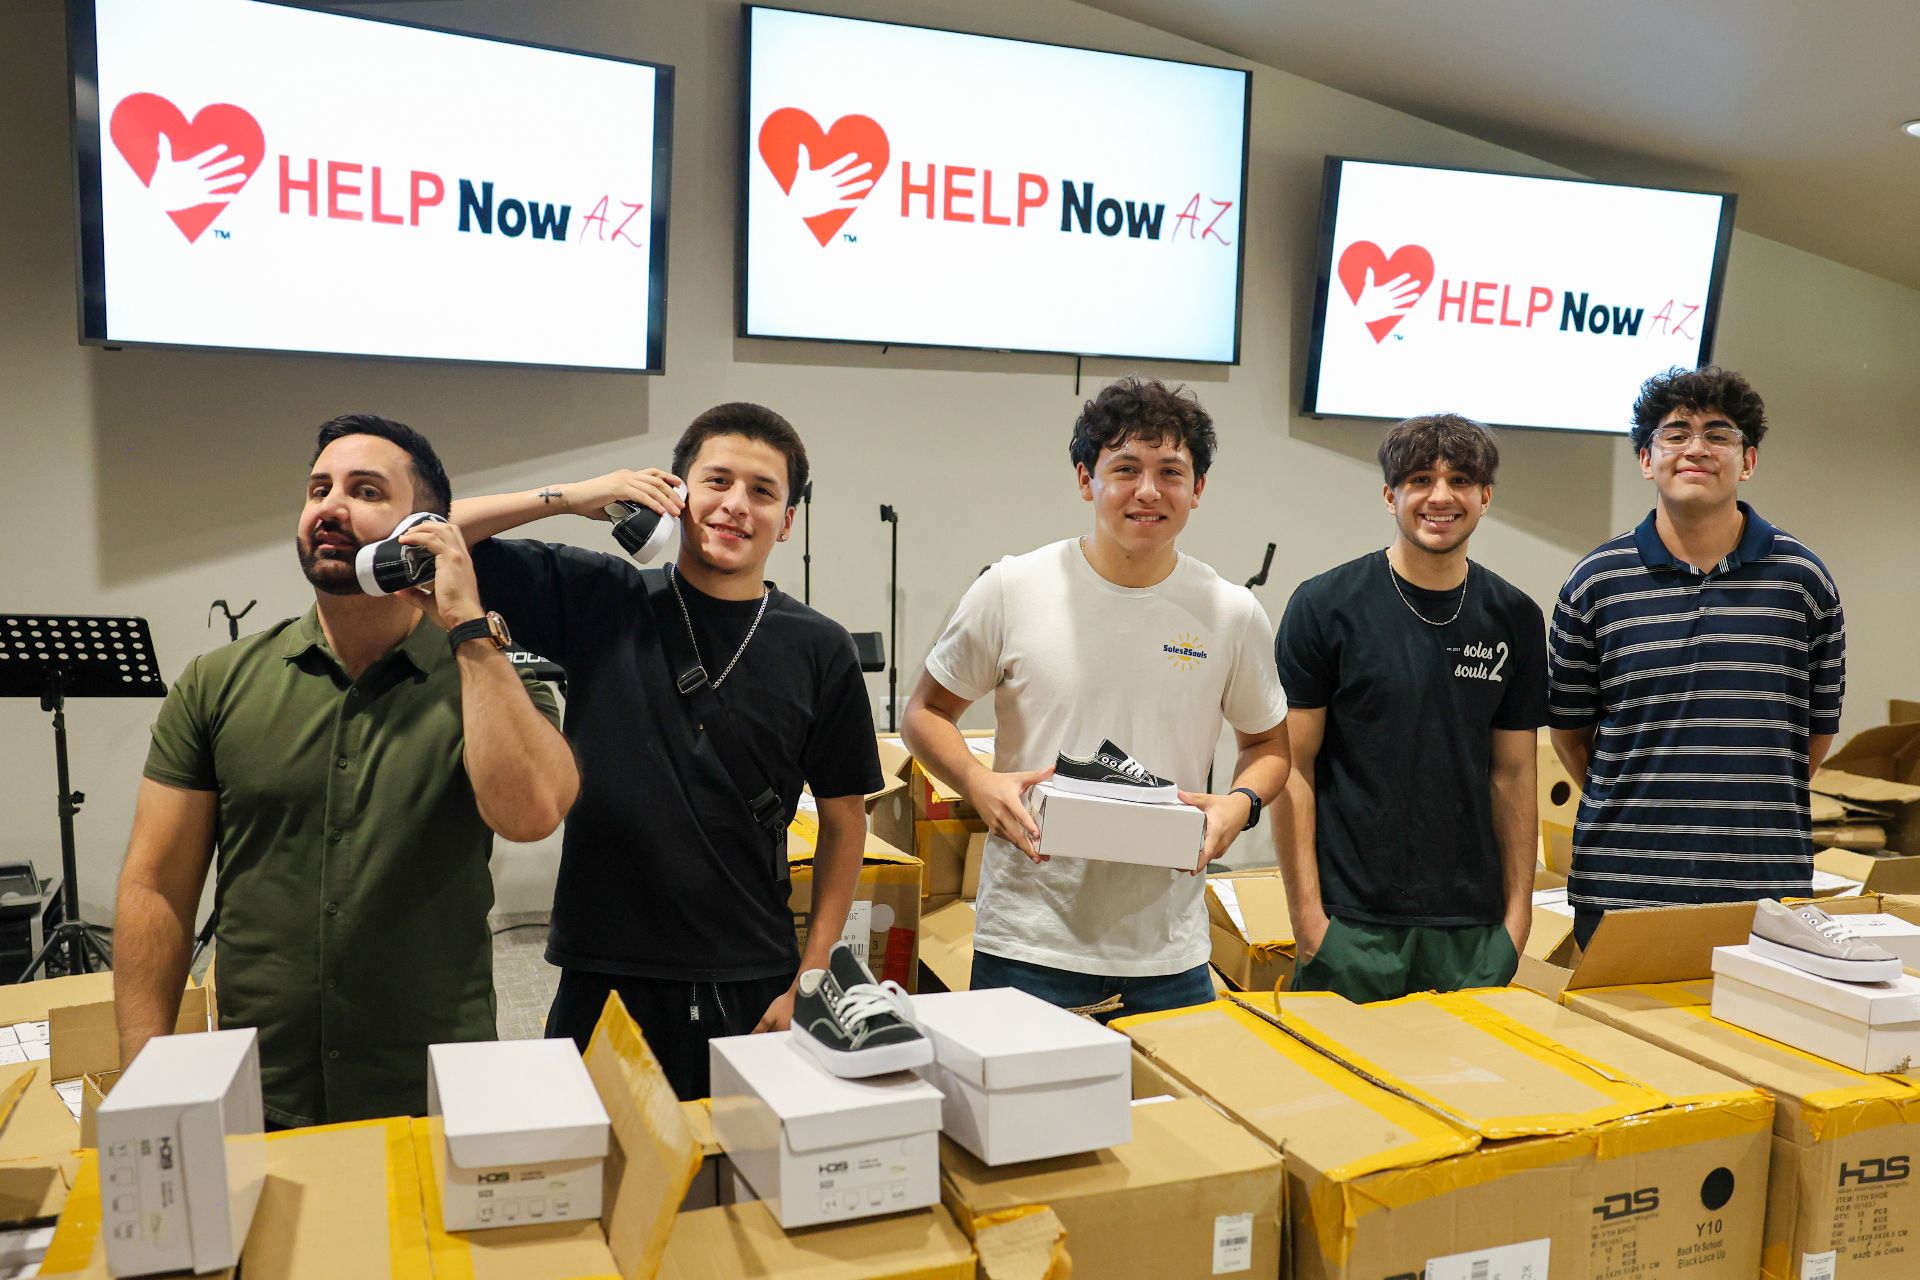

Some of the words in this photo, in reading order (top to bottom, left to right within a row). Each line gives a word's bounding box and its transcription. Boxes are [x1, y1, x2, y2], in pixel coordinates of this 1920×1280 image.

[278, 154, 446, 227] HELP
[458, 177, 573, 242] Now
[579, 194, 645, 249] AZ
[900, 160, 1050, 228] HELP
[1059, 178, 1167, 241] Now
[1172, 192, 1234, 247] AZ
[213, 229, 231, 240] TM
[842, 233, 858, 243] TM
[1438, 278, 1554, 328] HELP
[1559, 290, 1645, 337] Now
[1649, 299, 1701, 341] AZ
[1163, 644, 1207, 659] Soles2Souls
[1454, 661, 1488, 680] souls
[1463, 641, 1493, 660] soles
[1488, 641, 1509, 682] 2
[1838, 1155, 1910, 1187] HDS
[1696, 1218, 1722, 1238] Y10
[1702, 1238, 1723, 1251] School
[1884, 1246, 1904, 1255] CHINA
